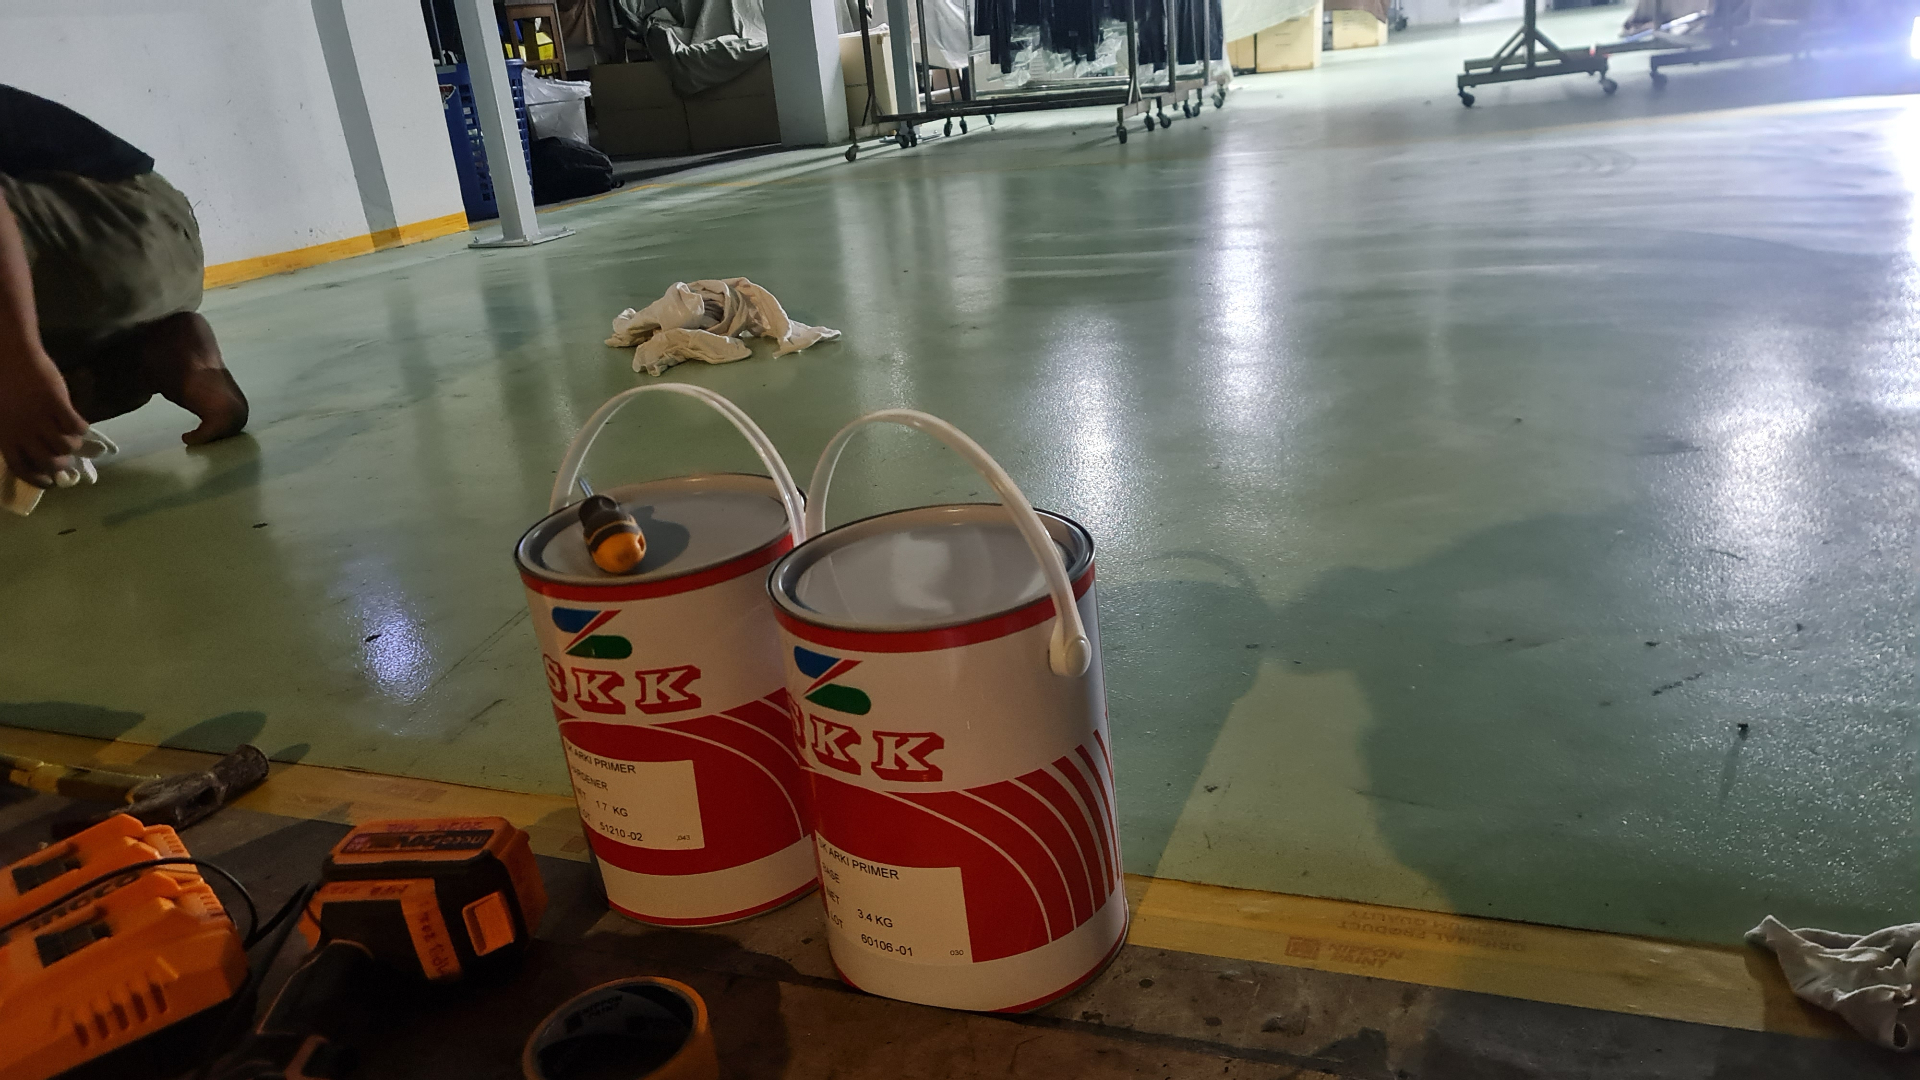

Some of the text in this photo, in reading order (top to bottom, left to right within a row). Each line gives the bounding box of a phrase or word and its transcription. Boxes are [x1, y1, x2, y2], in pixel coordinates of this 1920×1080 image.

[542, 653, 701, 715] SKK
[574, 748, 593, 765] ARKI
[594, 758, 637, 774] PRIMER
[612, 805, 629, 817] KG
[829, 847, 850, 867] ARKI
[851, 859, 900, 880] PRIMER
[830, 910, 844, 929] LOT
[857, 908, 873, 923] 3.4
[875, 915, 894, 928] KG
[1349, 909, 1427, 928] QUALITY
[1336, 920, 1426, 940] PRODUCT
